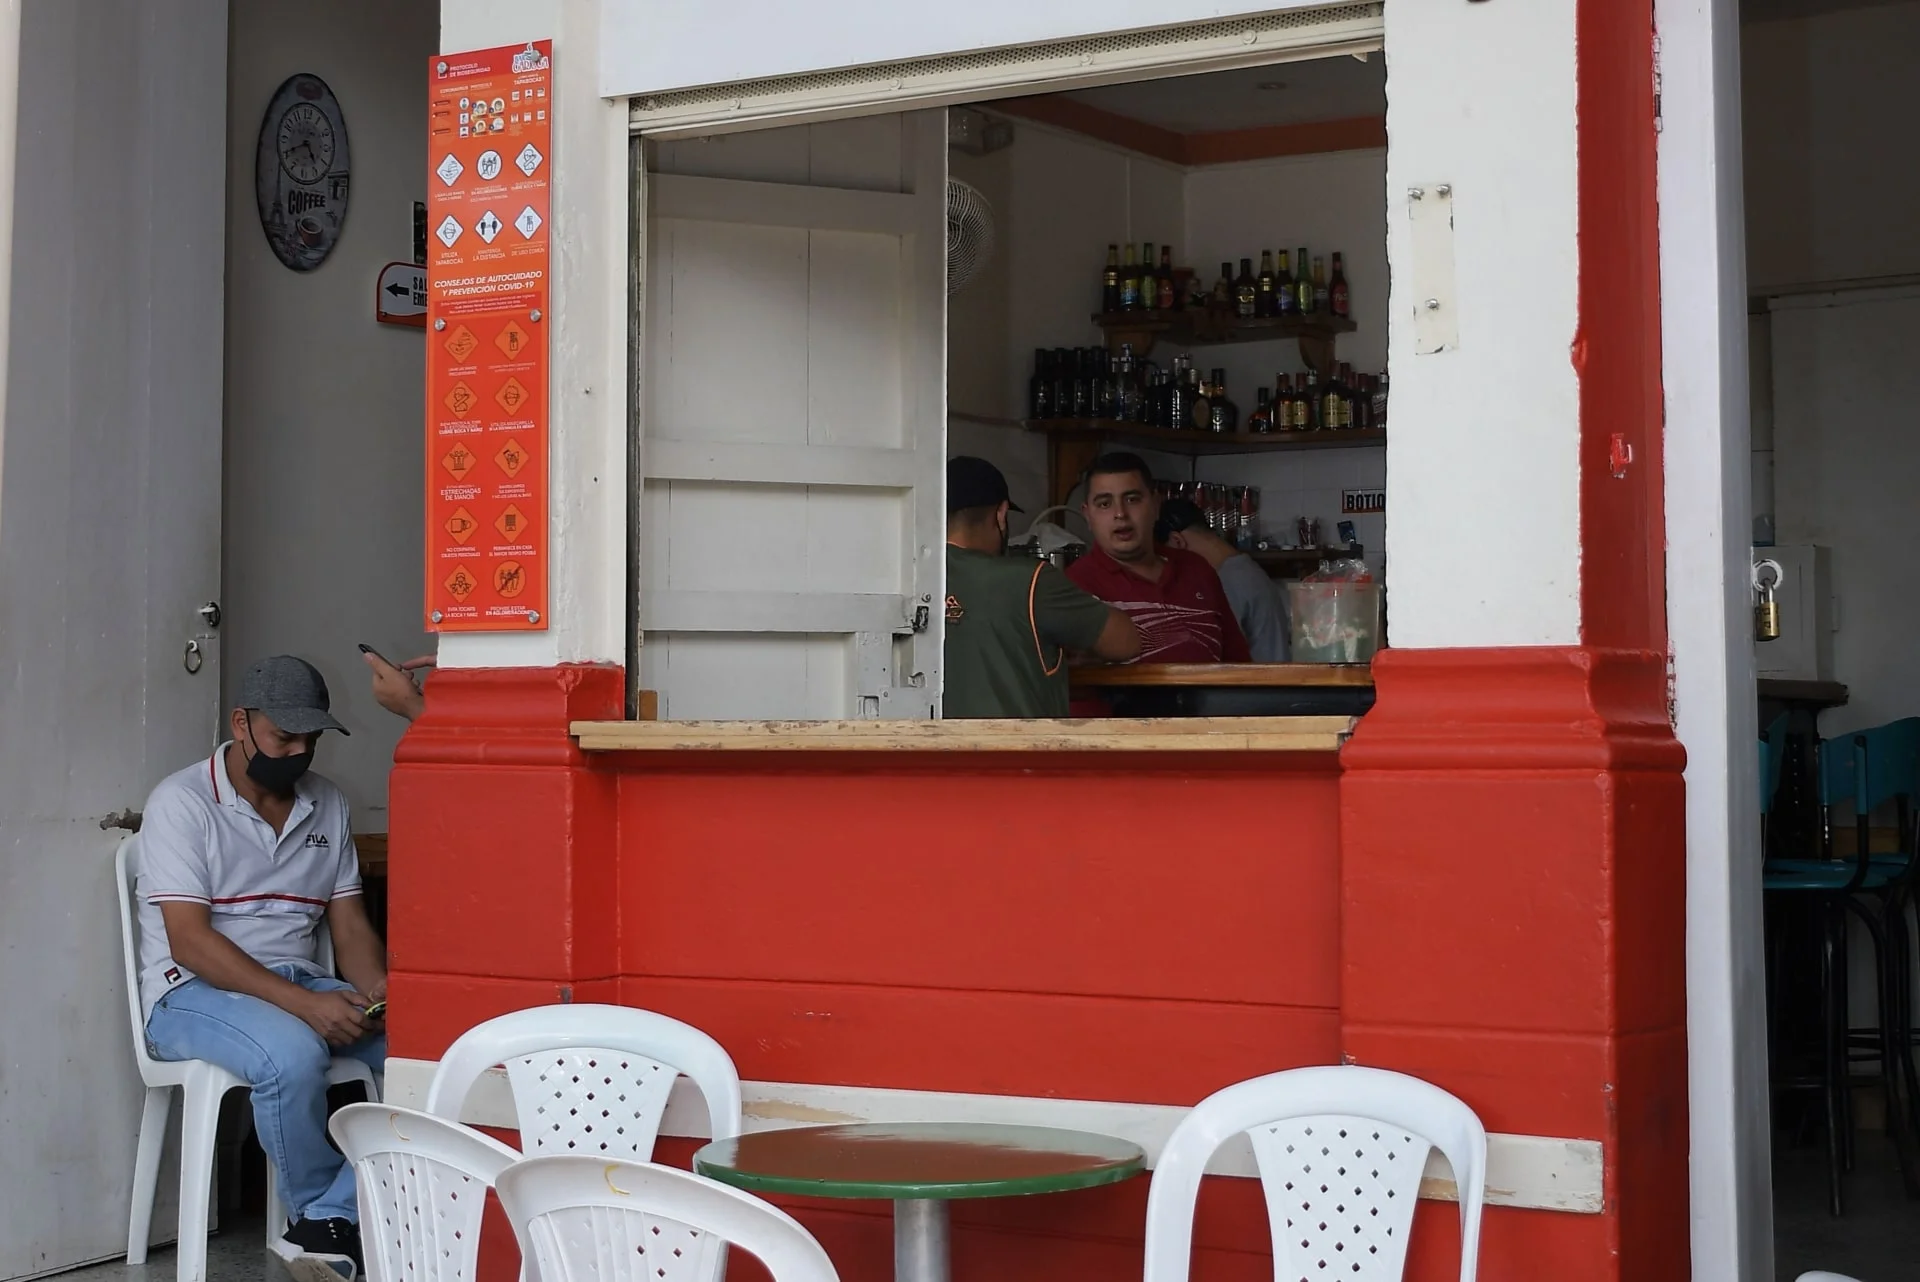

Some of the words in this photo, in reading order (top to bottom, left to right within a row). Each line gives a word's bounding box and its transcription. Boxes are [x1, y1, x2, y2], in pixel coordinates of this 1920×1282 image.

[287, 189, 326, 216] COFFEE
[434, 277, 474, 288] CONSEJOS
[476, 276, 486, 284] DE
[487, 270, 542, 283] AUTOCUIDADO
[497, 281, 534, 291] COVID-19
[306, 833, 328, 845] FILA
